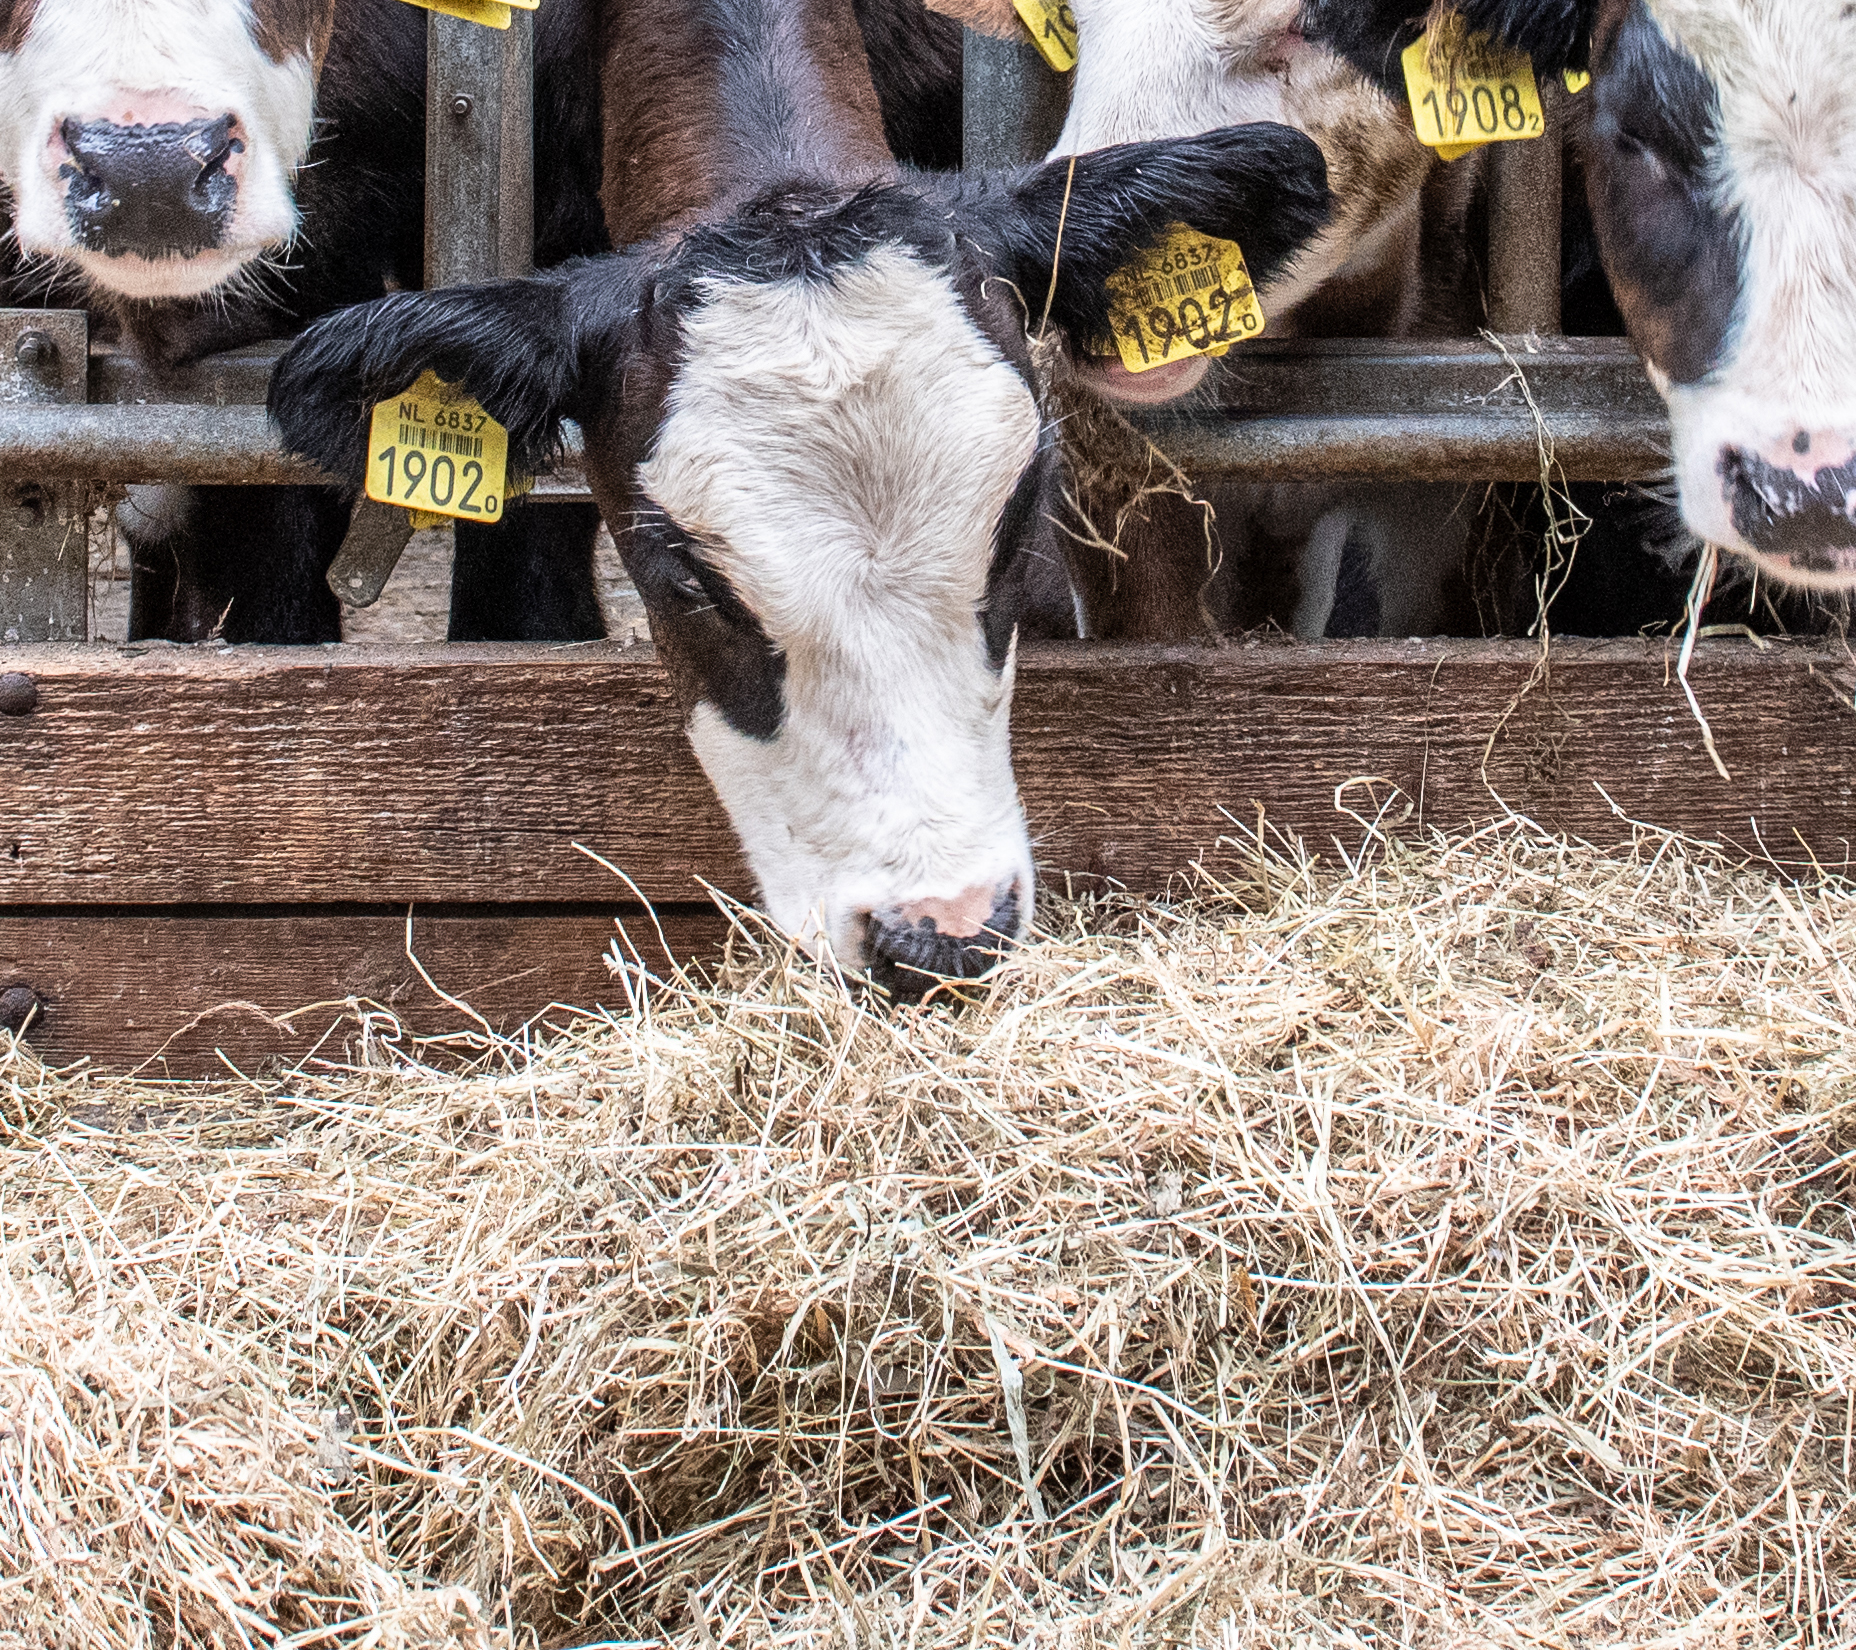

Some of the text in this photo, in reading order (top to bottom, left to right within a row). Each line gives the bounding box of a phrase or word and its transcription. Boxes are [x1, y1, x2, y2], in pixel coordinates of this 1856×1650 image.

[1422, 82, 1526, 138] 1908
[1125, 286, 1243, 364] 1902
[398, 402, 488, 434] NL 6837
[377, 445, 484, 514] 1902
